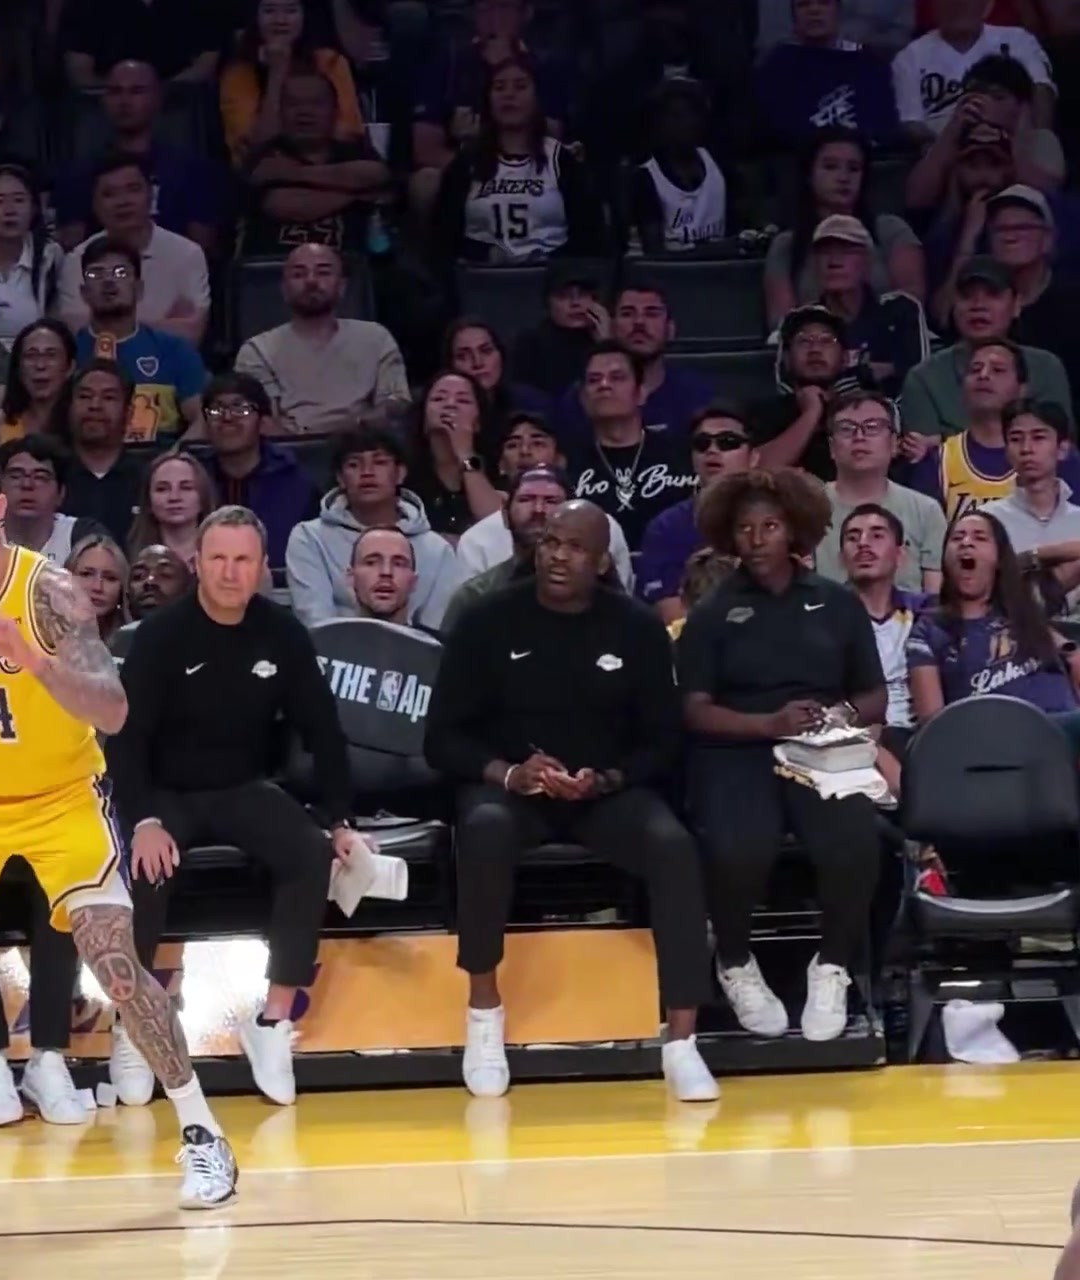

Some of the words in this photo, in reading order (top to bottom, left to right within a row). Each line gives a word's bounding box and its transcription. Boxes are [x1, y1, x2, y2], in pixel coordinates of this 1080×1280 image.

[477, 178, 544, 198] LAKERS
[492, 204, 528, 239] 15
[330, 659, 377, 705] THE
